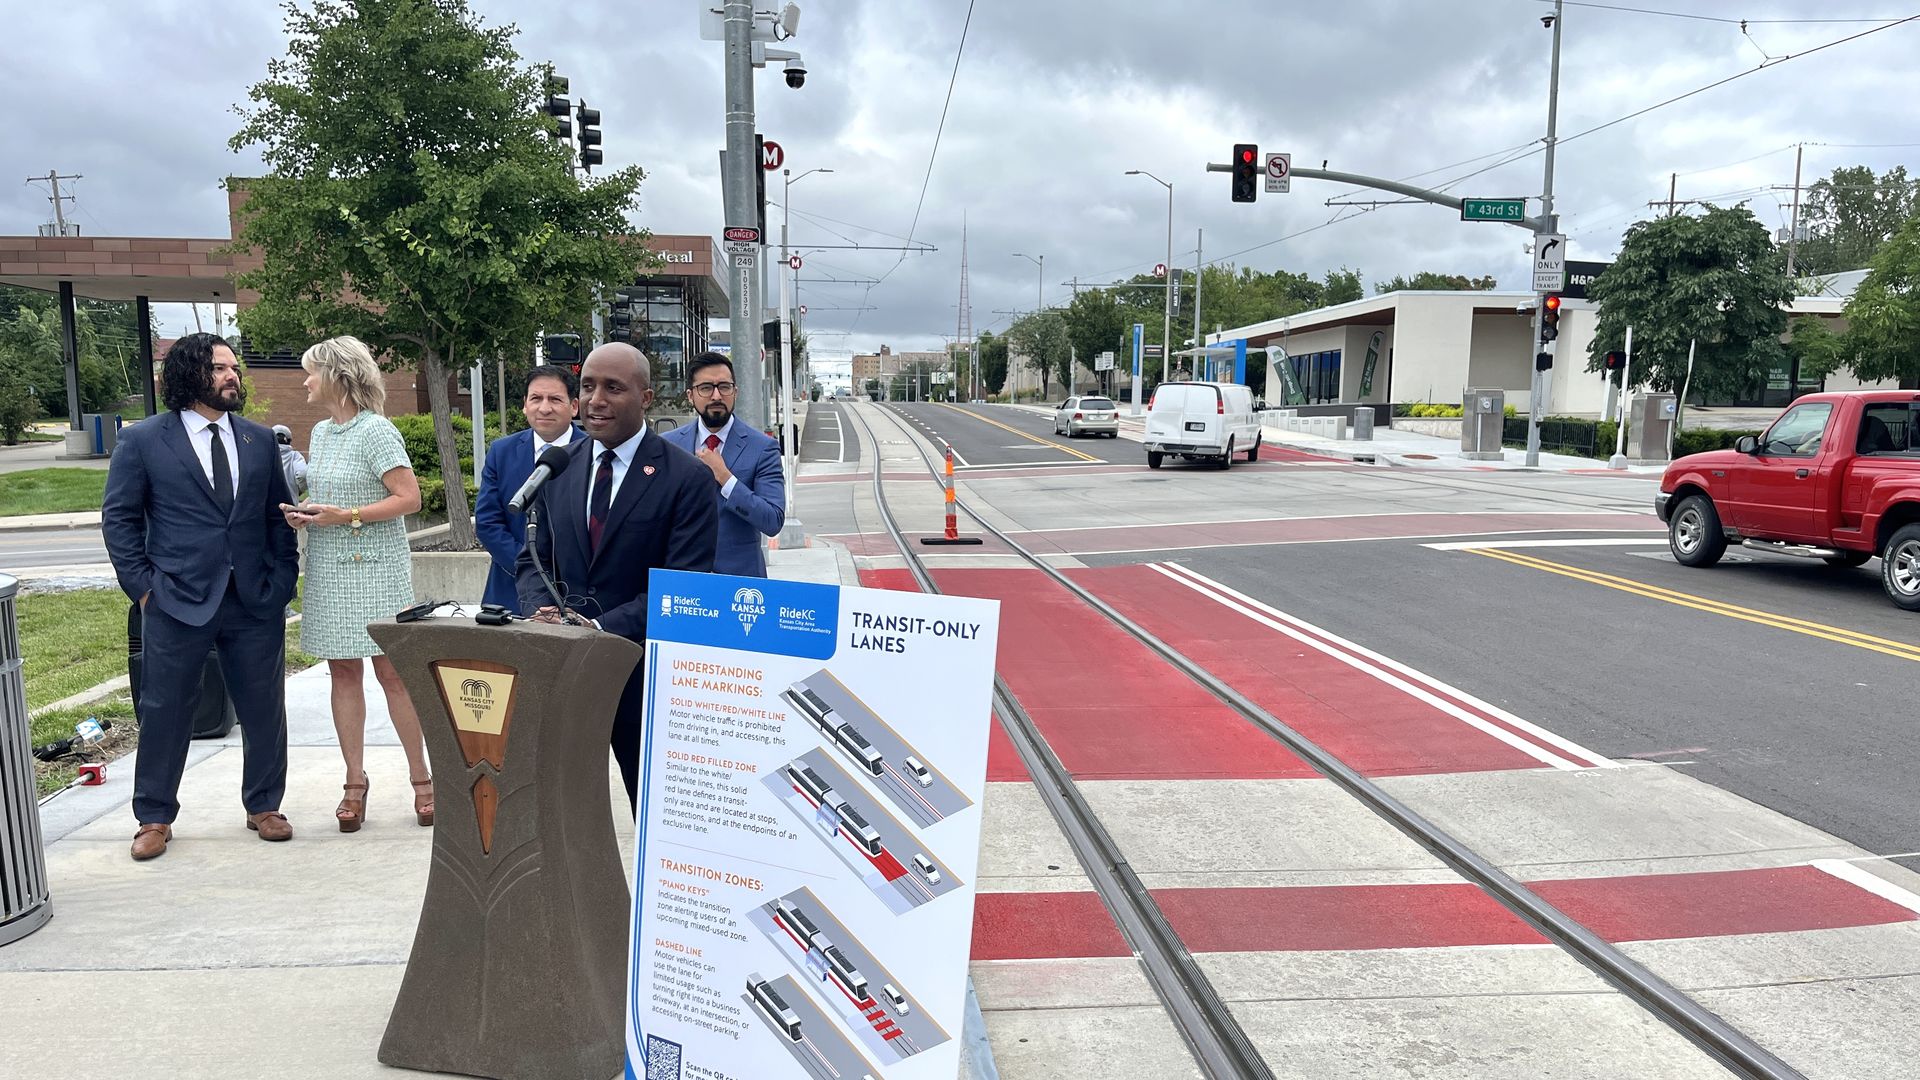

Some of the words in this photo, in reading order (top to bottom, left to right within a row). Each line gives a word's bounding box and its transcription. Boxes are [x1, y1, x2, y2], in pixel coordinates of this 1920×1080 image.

[763, 146, 778, 166] M
[1478, 204, 1503, 216] 43rd
[1508, 205, 1519, 216] St
[737, 258, 752, 266] 249
[792, 259, 799, 268] M
[1156, 266, 1164, 276] M
[674, 596, 700, 606] RideKC
[731, 603, 766, 614] KANSAS
[674, 606, 719, 618] STREETCAR
[738, 614, 757, 623] CITY
[779, 607, 815, 621] RideKC
[779, 624, 810, 632] Transportation
[852, 612, 980, 640] TRANSIT-ONLY
[851, 633, 905, 653] LANES
[673, 660, 762, 681] UNDERSTANDING
[672, 676, 698, 688] LANE
[702, 679, 762, 697] MARKINGS:
[670, 697, 692, 707] SOLID
[695, 701, 766, 718] WHITE/RED/WHITE
[768, 712, 786, 721] LINE
[669, 710, 690, 718] Motor
[693, 712, 715, 723] vehicle
[717, 716, 735, 726] traffic
[745, 720, 781, 733] prohibited
[668, 731, 681, 740] lane
[701, 737, 720, 747] times.
[669, 720, 684, 729] from
[687, 722, 708, 735] driving
[721, 728, 733, 737] and
[736, 731, 771, 745] accessing,
[773, 736, 786, 745] this
[666, 762, 688, 772] Similar
[699, 768, 709, 777] the
[711, 771, 732, 781] white/
[667, 751, 689, 761] SOLID
[691, 754, 706, 763] RED
[708, 758, 733, 768] FILLED
[735, 762, 757, 773] ZONE
[665, 774, 696, 786] red/white
[698, 778, 716, 790] lines,
[717, 782, 729, 792] this
[730, 785, 748, 795] solid
[665, 785, 676, 793] red
[678, 786, 691, 796] lane
[692, 789, 716, 801] defines
[724, 796, 748, 806] transit-
[664, 796, 678, 806] only
[680, 800, 694, 808] area
[696, 801, 708, 811] and
[710, 805, 721, 813] are
[722, 806, 747, 819] located
[757, 815, 778, 826] stops,
[662, 818, 692, 830] exclusive
[694, 823, 709, 834] lane.
[663, 808, 706, 823] intersections,
[708, 815, 720, 825] and
[722, 818, 729, 826] at
[730, 820, 742, 829] the
[743, 822, 777, 837] endpoints
[660, 858, 722, 881] TRANSITION
[725, 873, 764, 891] ZONES:
[658, 890, 686, 904] Indicates
[688, 897, 699, 906] the
[700, 900, 730, 914] transition
[657, 902, 673, 911] zone
[674, 906, 698, 919] alerting
[700, 913, 717, 923] users
[719, 917, 726, 925] of
[656, 914, 688, 929] upcoming
[690, 921, 728, 937] mixed-used
[730, 932, 748, 942] zone.
[655, 938, 684, 952] DASHED
[686, 947, 702, 957] LINE
[655, 950, 675, 960] Motor
[676, 957, 702, 969] vehicles
[704, 964, 716, 972] can
[666, 964, 676, 973] the
[678, 967, 691, 977] lane
[693, 971, 702, 980] for
[653, 971, 674, 984] limited
[676, 980, 695, 990] usage
[696, 985, 712, 995] such
[653, 983, 674, 997] turning
[676, 989, 691, 1000] right
[692, 994, 704, 1004] into
[712, 1001, 740, 1015] business
[652, 994, 682, 1009] driveway,
[701, 1008, 740, 1028] intersection,
[652, 1006, 682, 1022] accessing
[684, 1015, 713, 1030] on-street
[714, 1025, 740, 1040] parking.
[685, 1070, 694, 1079] for
[686, 1061, 701, 1073] Scan
[702, 1068, 712, 1076] the
[714, 1071, 724, 1080] QR
